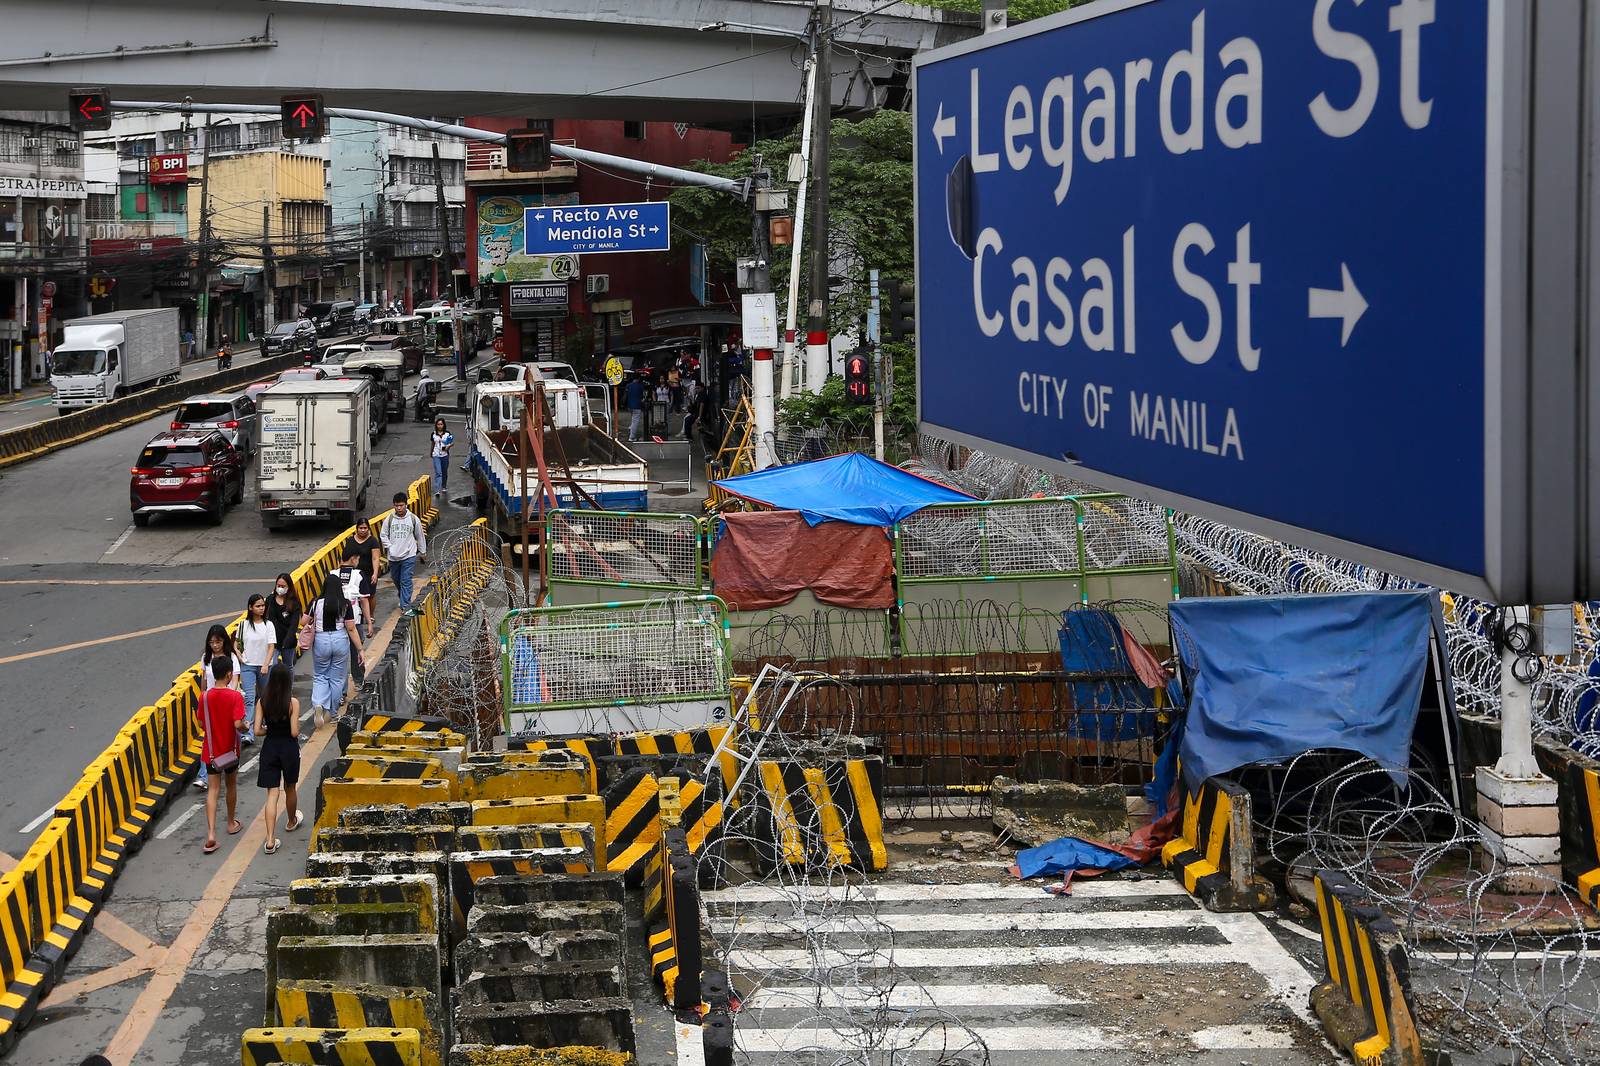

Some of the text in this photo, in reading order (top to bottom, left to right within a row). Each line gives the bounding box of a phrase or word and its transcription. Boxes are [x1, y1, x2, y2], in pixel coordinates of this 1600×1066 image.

[970, 0, 1436, 206] Legarda St
[163, 158, 183, 169] BPI
[42, 180, 85, 192] PEPITA
[552, 206, 639, 223] Recto Ave
[548, 223, 646, 241] Mendiola St
[556, 260, 571, 273] 24
[521, 286, 567, 298] DENTAL CLINIC
[973, 222, 1261, 372] Casal St
[849, 382, 866, 396] 41
[1019, 371, 1244, 461] CITY OF MANILA
